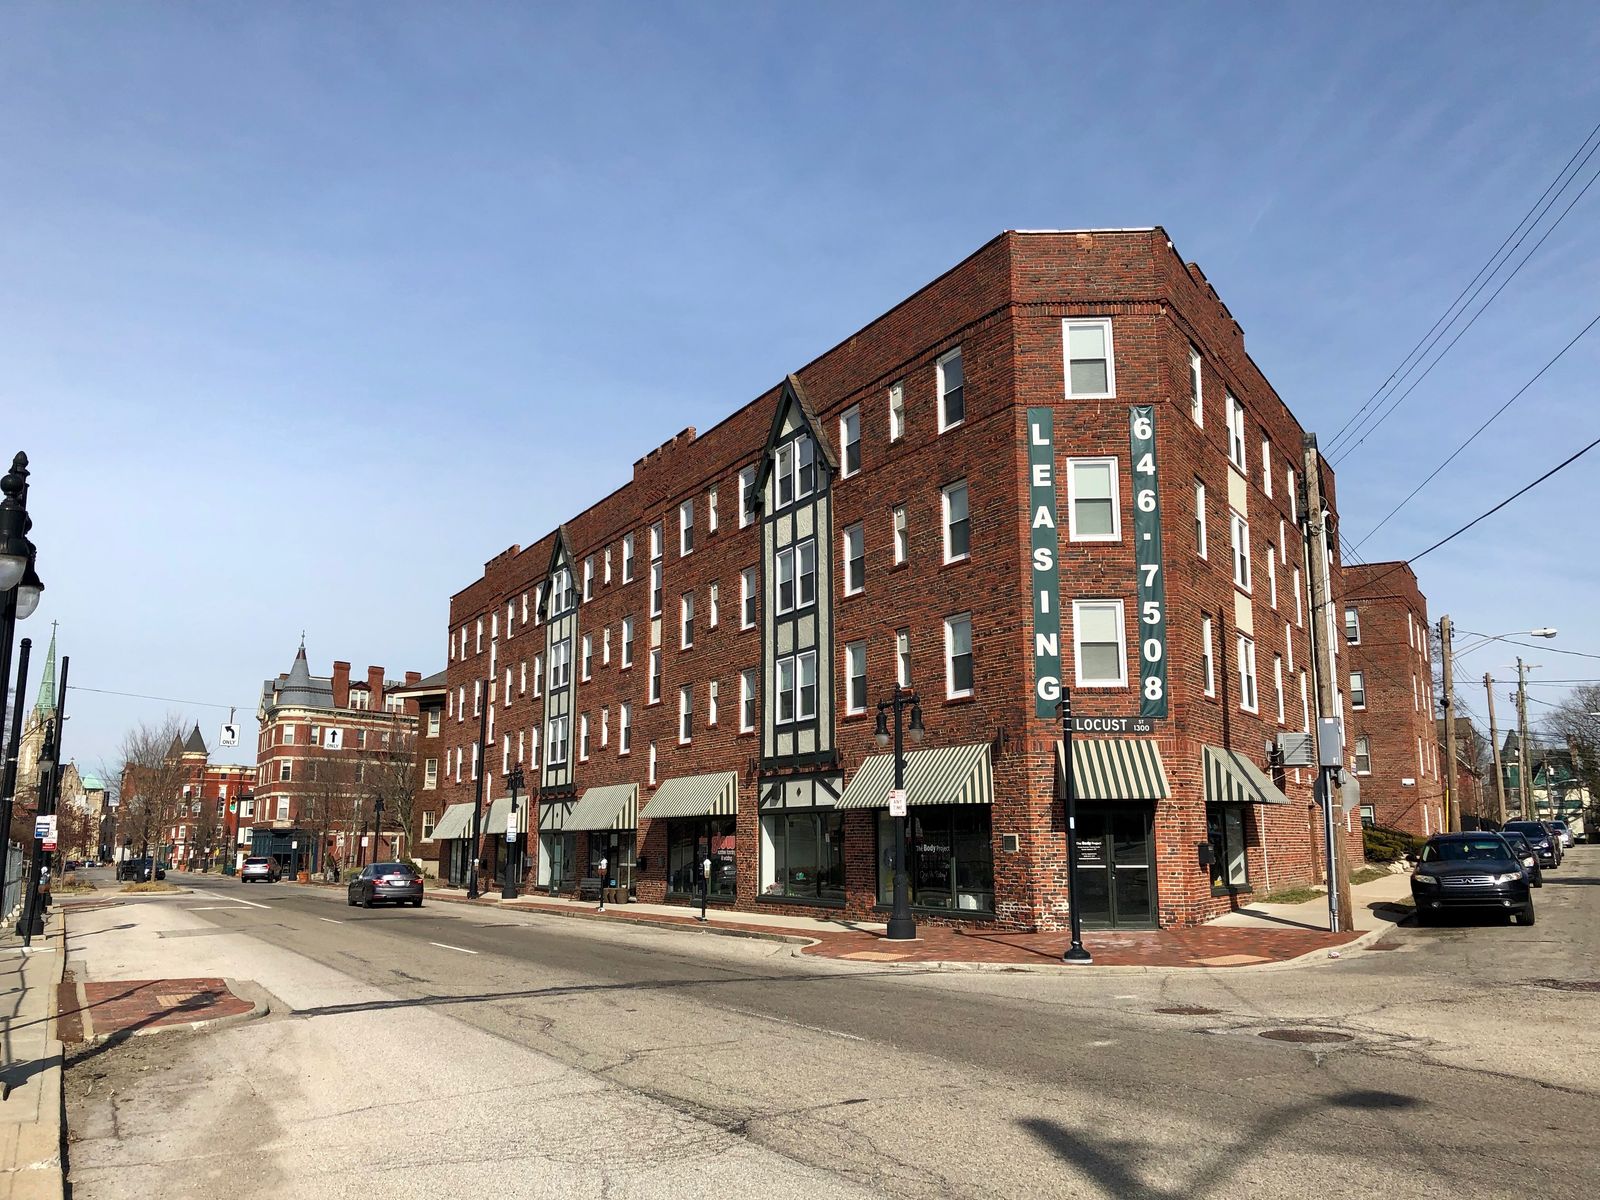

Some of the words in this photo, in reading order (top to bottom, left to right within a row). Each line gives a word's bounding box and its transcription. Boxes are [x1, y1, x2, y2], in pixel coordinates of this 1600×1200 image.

[1030, 422, 1060, 701] LEASING
[1076, 718, 1128, 732] LOCUST
[923, 844, 936, 853] Body
